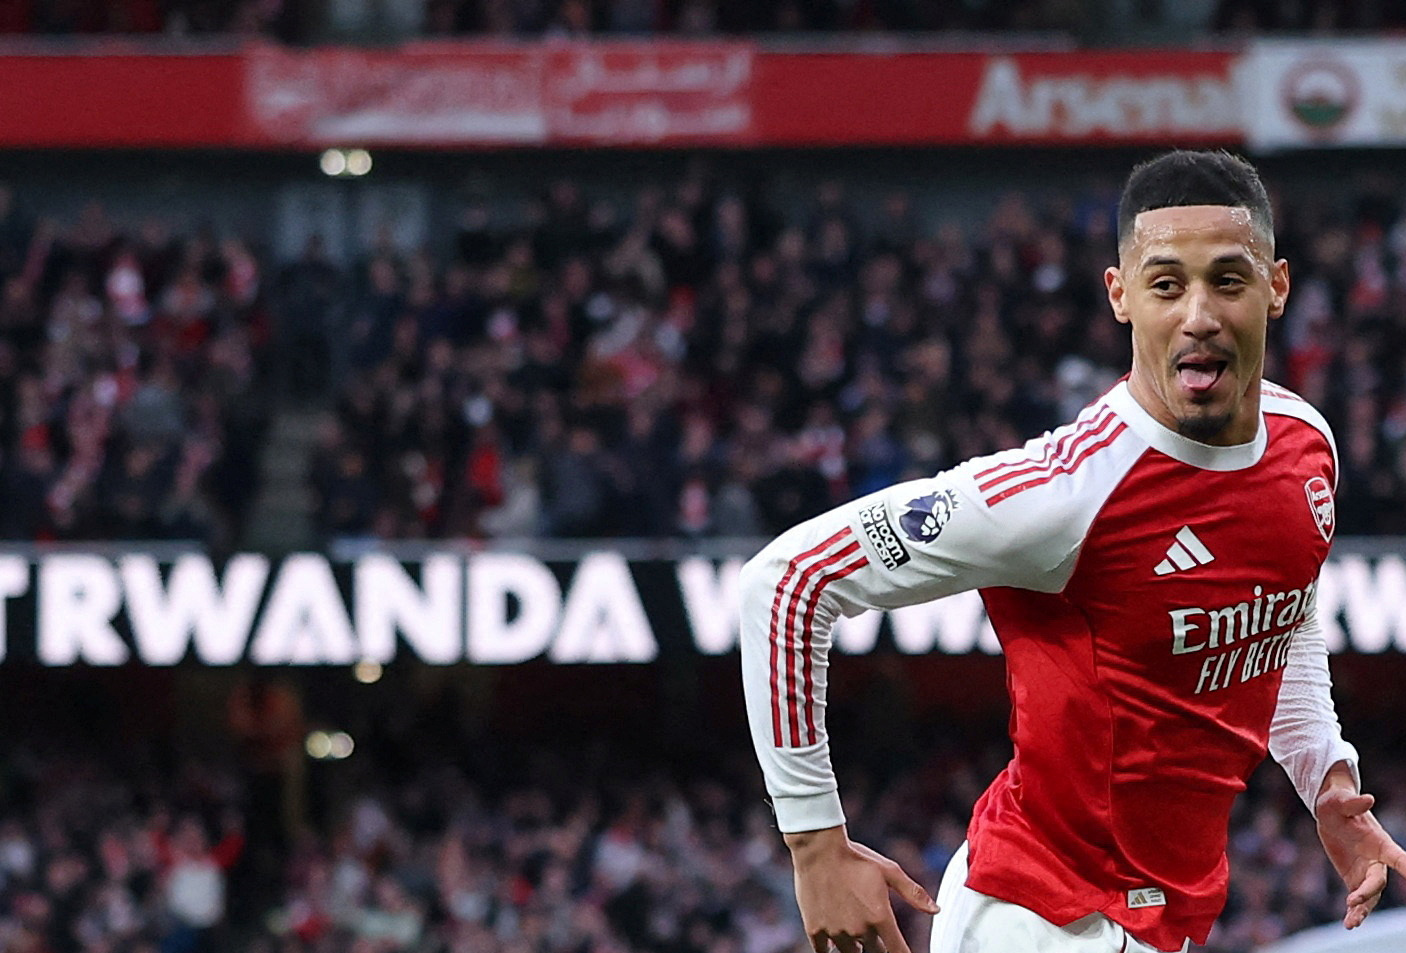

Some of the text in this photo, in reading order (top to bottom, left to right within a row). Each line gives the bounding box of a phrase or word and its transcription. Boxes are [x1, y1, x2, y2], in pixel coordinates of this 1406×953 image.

[865, 524, 898, 570] racism
[875, 520, 904, 560] room
[37, 553, 661, 666] RWANDA
[1194, 647, 1242, 694] FLY
